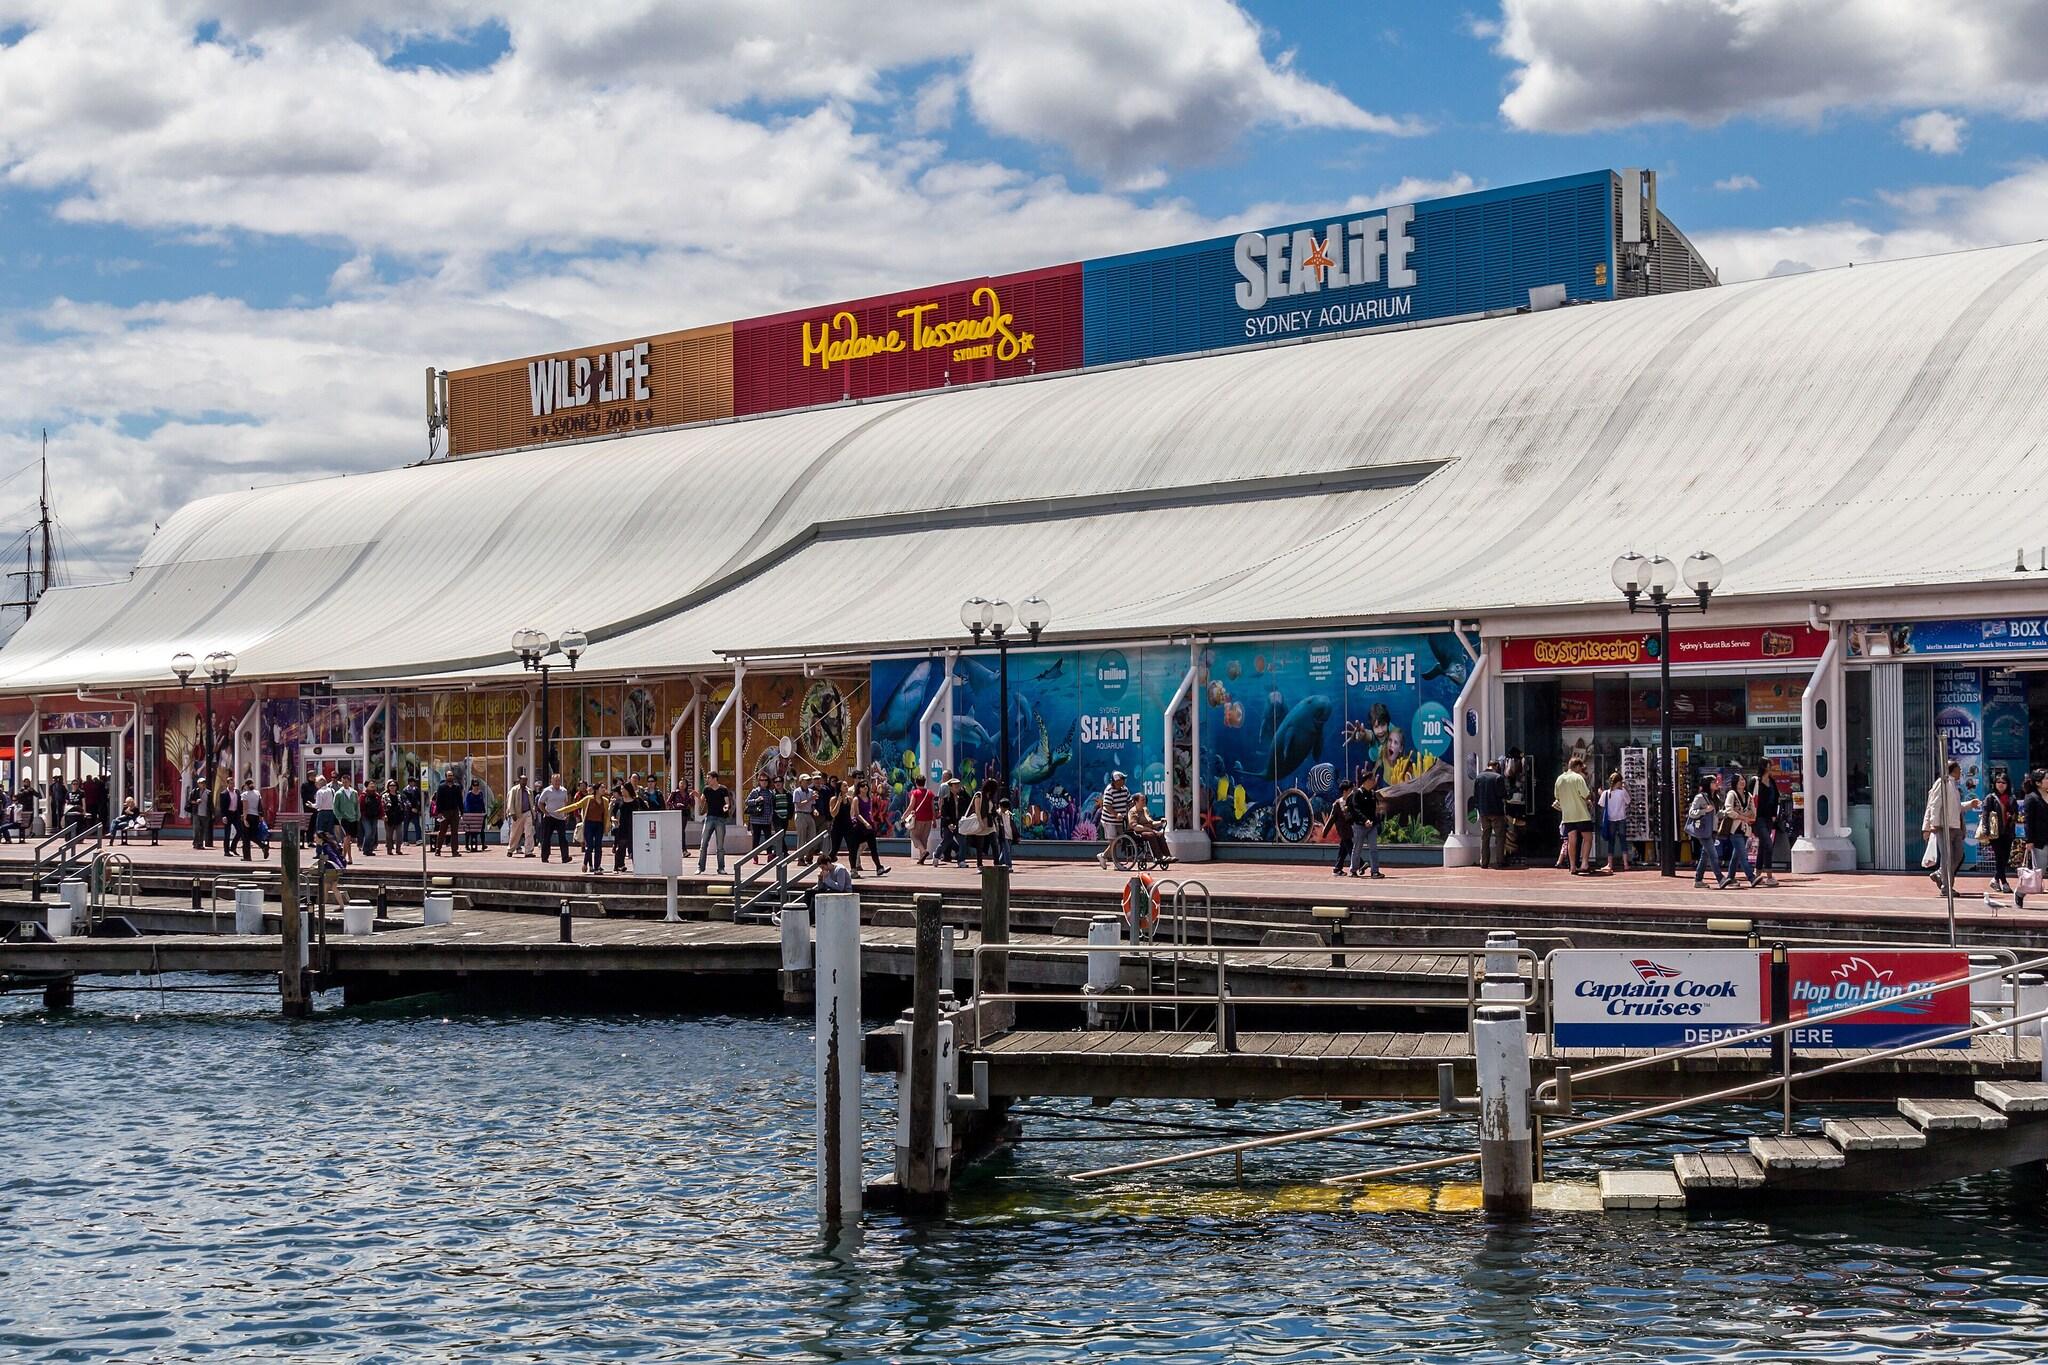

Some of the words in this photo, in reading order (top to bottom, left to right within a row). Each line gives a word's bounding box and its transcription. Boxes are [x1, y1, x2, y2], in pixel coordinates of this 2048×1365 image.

[1245, 309, 1312, 338] SYDNEY
[1318, 295, 1411, 328] AQUARIUM
[802, 311, 906, 370] Madame
[897, 287, 1024, 362] Tussauds
[953, 344, 994, 362] SYDNEY
[528, 358, 592, 417] WILD
[598, 341, 650, 403] LIFE
[550, 412, 601, 436] SYDNEY
[605, 407, 631, 428] ZOO
[2010, 621, 2041, 637] BOX
[1535, 640, 1639, 664] CitySightseeing
[1679, 642, 1703, 652] Sydney's
[1703, 641, 1720, 649] Tourist
[1720, 640, 1731, 648] Bus
[1731, 640, 1751, 648] Service
[1346, 655, 1379, 686] SEA
[1364, 684, 1396, 692] AQUARIUM
[1080, 715, 1108, 743] SEA
[1422, 721, 1441, 736] 700
[1096, 742, 1124, 750] AQUARIUM
[1952, 739, 1980, 754] Pass
[1284, 807, 1301, 829] 14
[1575, 980, 1671, 1001] Captain
[1674, 980, 1739, 997] Cook
[1792, 981, 1831, 1003] Hop
[1834, 982, 1860, 1000] On
[1606, 998, 1703, 1016] Cruises
[1811, 1004, 1834, 1014] Sydney
